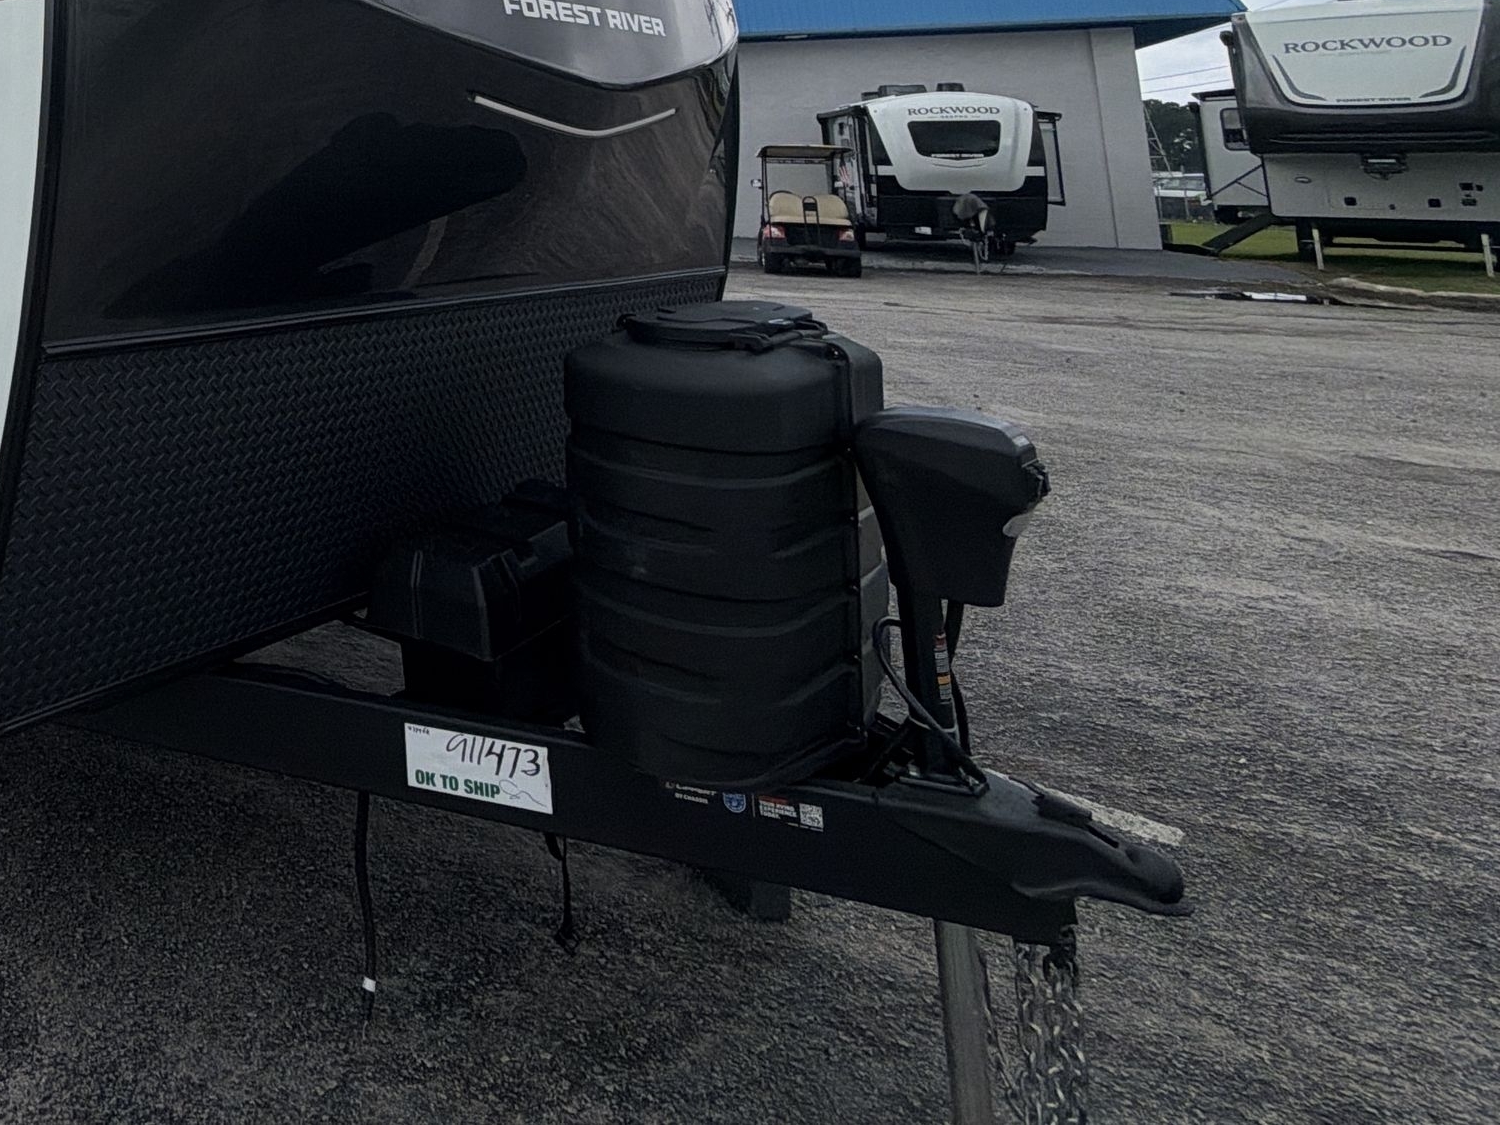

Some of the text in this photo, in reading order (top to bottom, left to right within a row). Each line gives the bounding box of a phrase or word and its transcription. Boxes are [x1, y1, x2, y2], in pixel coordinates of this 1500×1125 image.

[605, 8, 667, 37] RIVER
[1283, 34, 1452, 54] ROCKWOOD
[907, 106, 1000, 116] ROCKWOOD
[446, 733, 541, 779] 911473
[415, 769, 437, 787] OK
[440, 774, 459, 792] TO
[464, 778, 500, 799] SHIP
